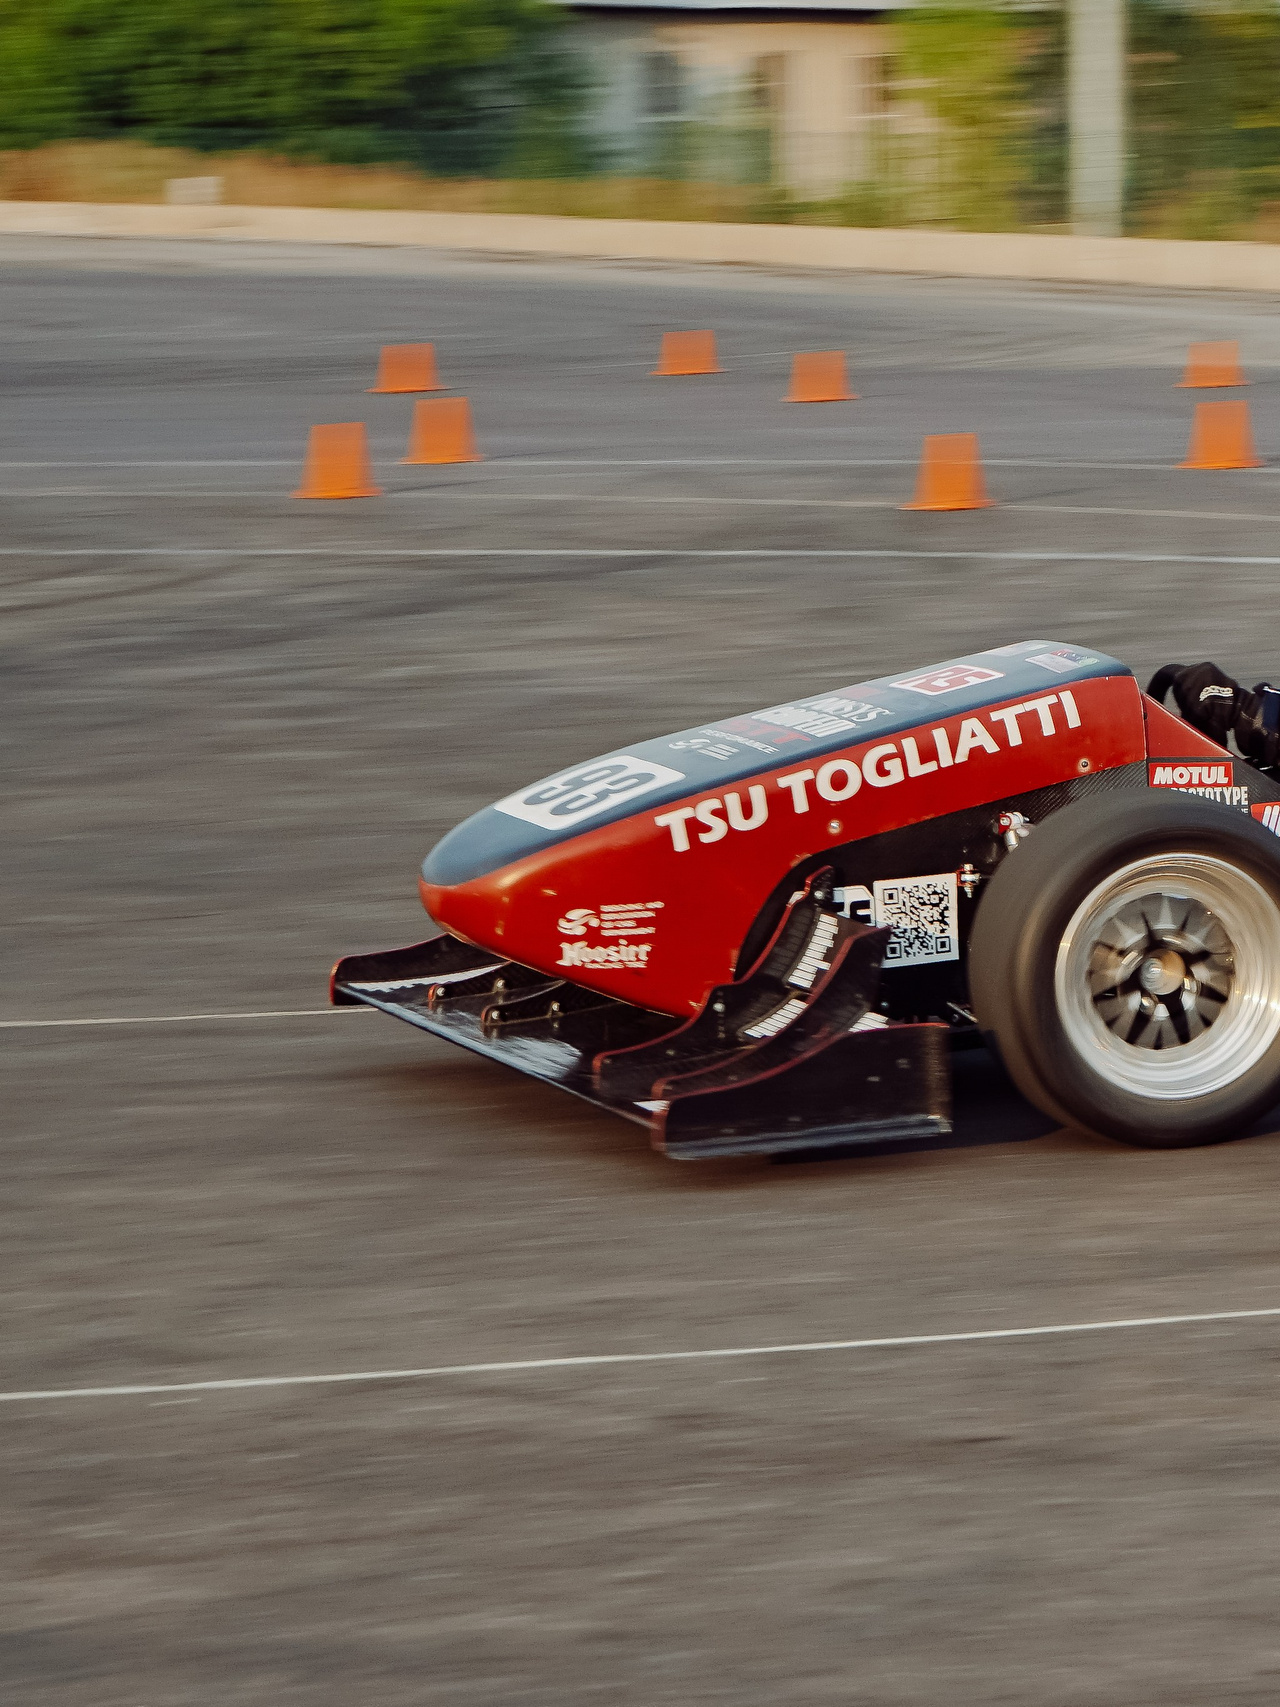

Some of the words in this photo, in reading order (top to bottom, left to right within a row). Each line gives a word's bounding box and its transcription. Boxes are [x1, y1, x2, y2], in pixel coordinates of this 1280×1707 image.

[522, 764, 657, 816] 93
[654, 784, 769, 853] TSU
[777, 690, 1082, 814] TOGLIATTI
[1153, 765, 1229, 785] MOTUL
